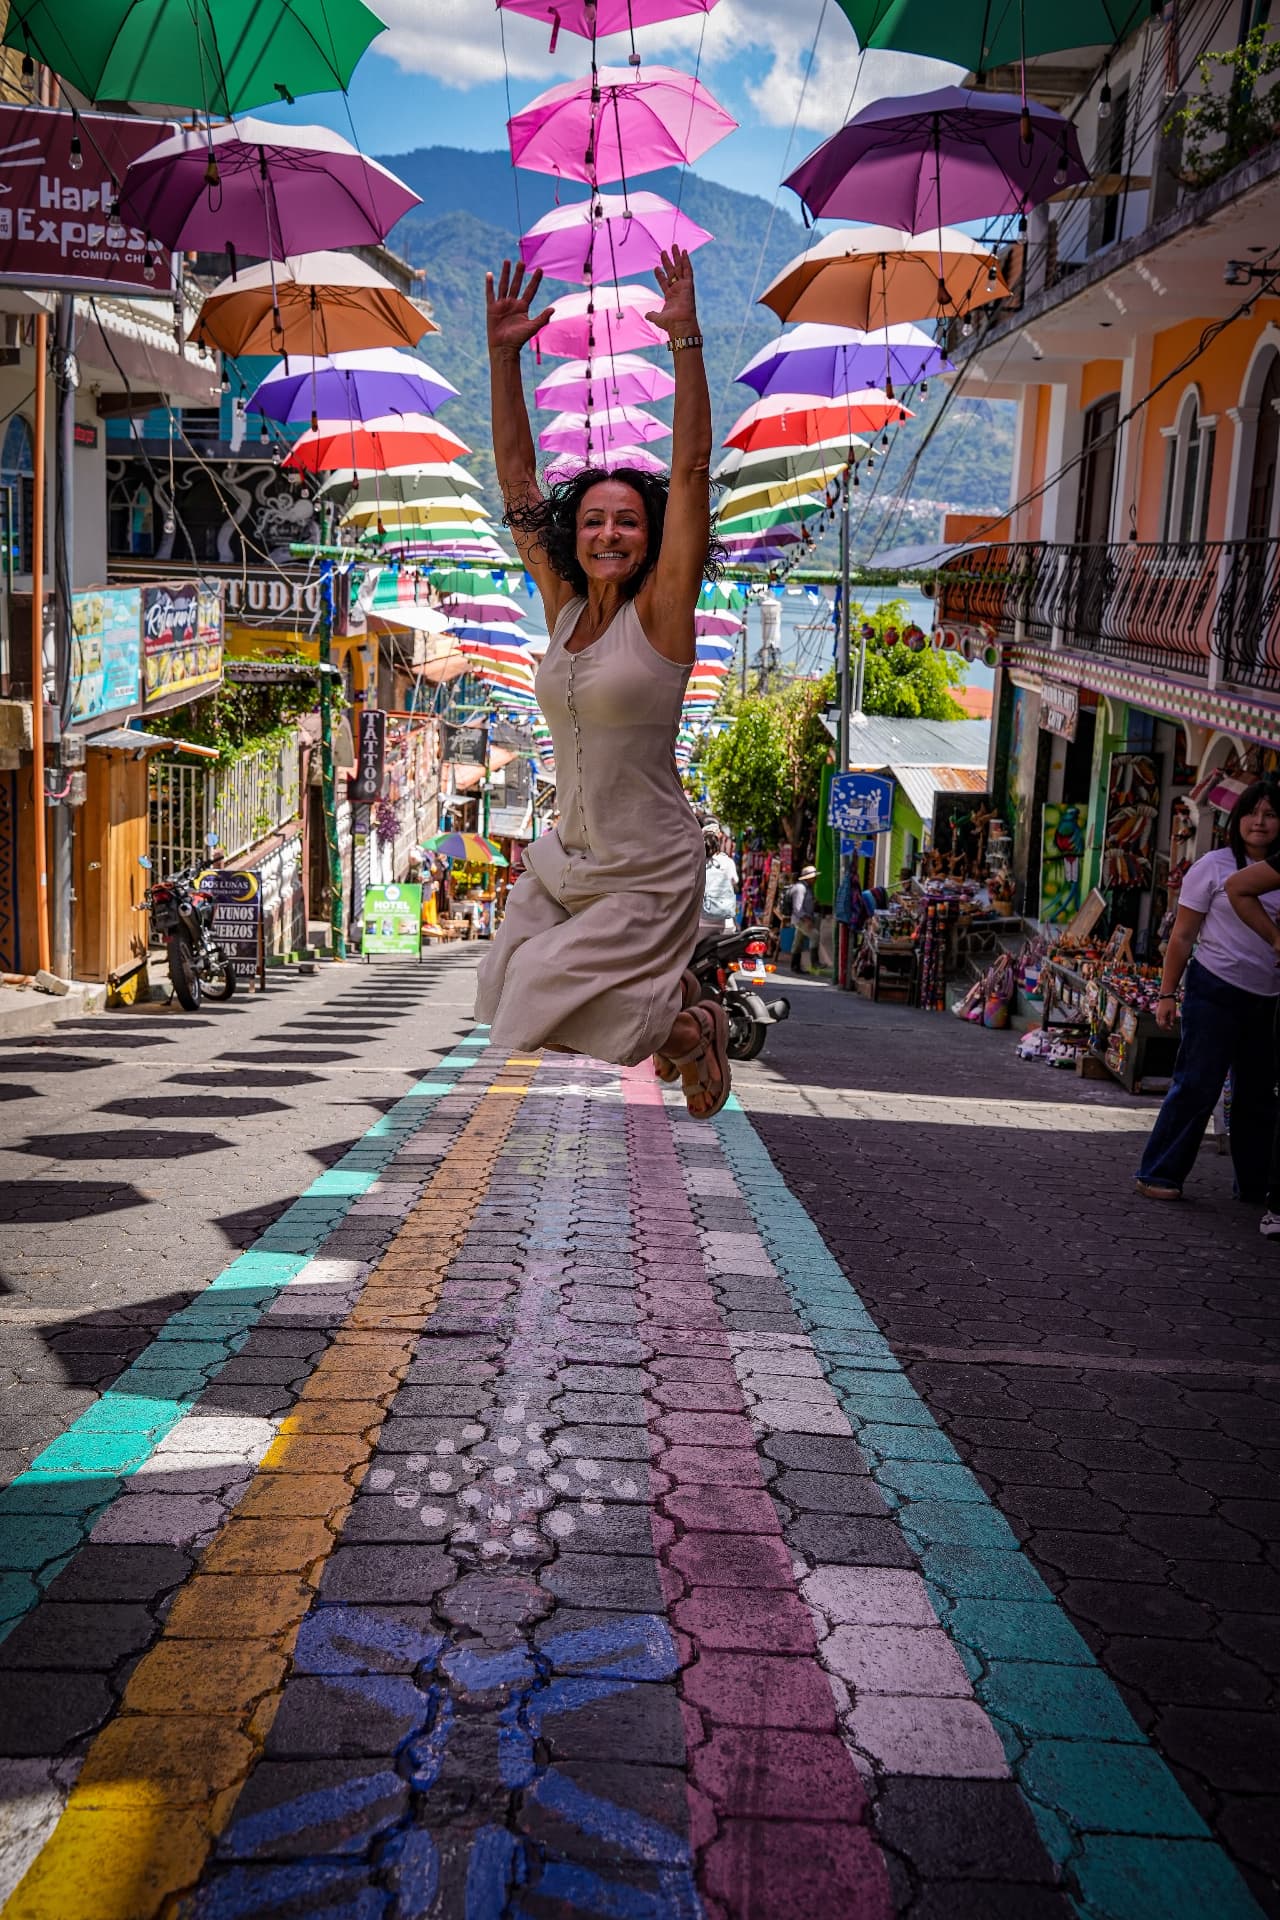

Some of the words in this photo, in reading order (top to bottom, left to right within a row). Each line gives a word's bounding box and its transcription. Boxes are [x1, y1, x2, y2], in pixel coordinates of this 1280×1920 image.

[72, 249, 121, 262] COMIDA
[125, 252, 162, 265] CHIA
[222, 578, 321, 612] TUDIO
[362, 712, 379, 793] TATTOO
[201, 880, 218, 889] DOS
[220, 881, 248, 889] LUNAS
[213, 906, 255, 920] AYUNOS
